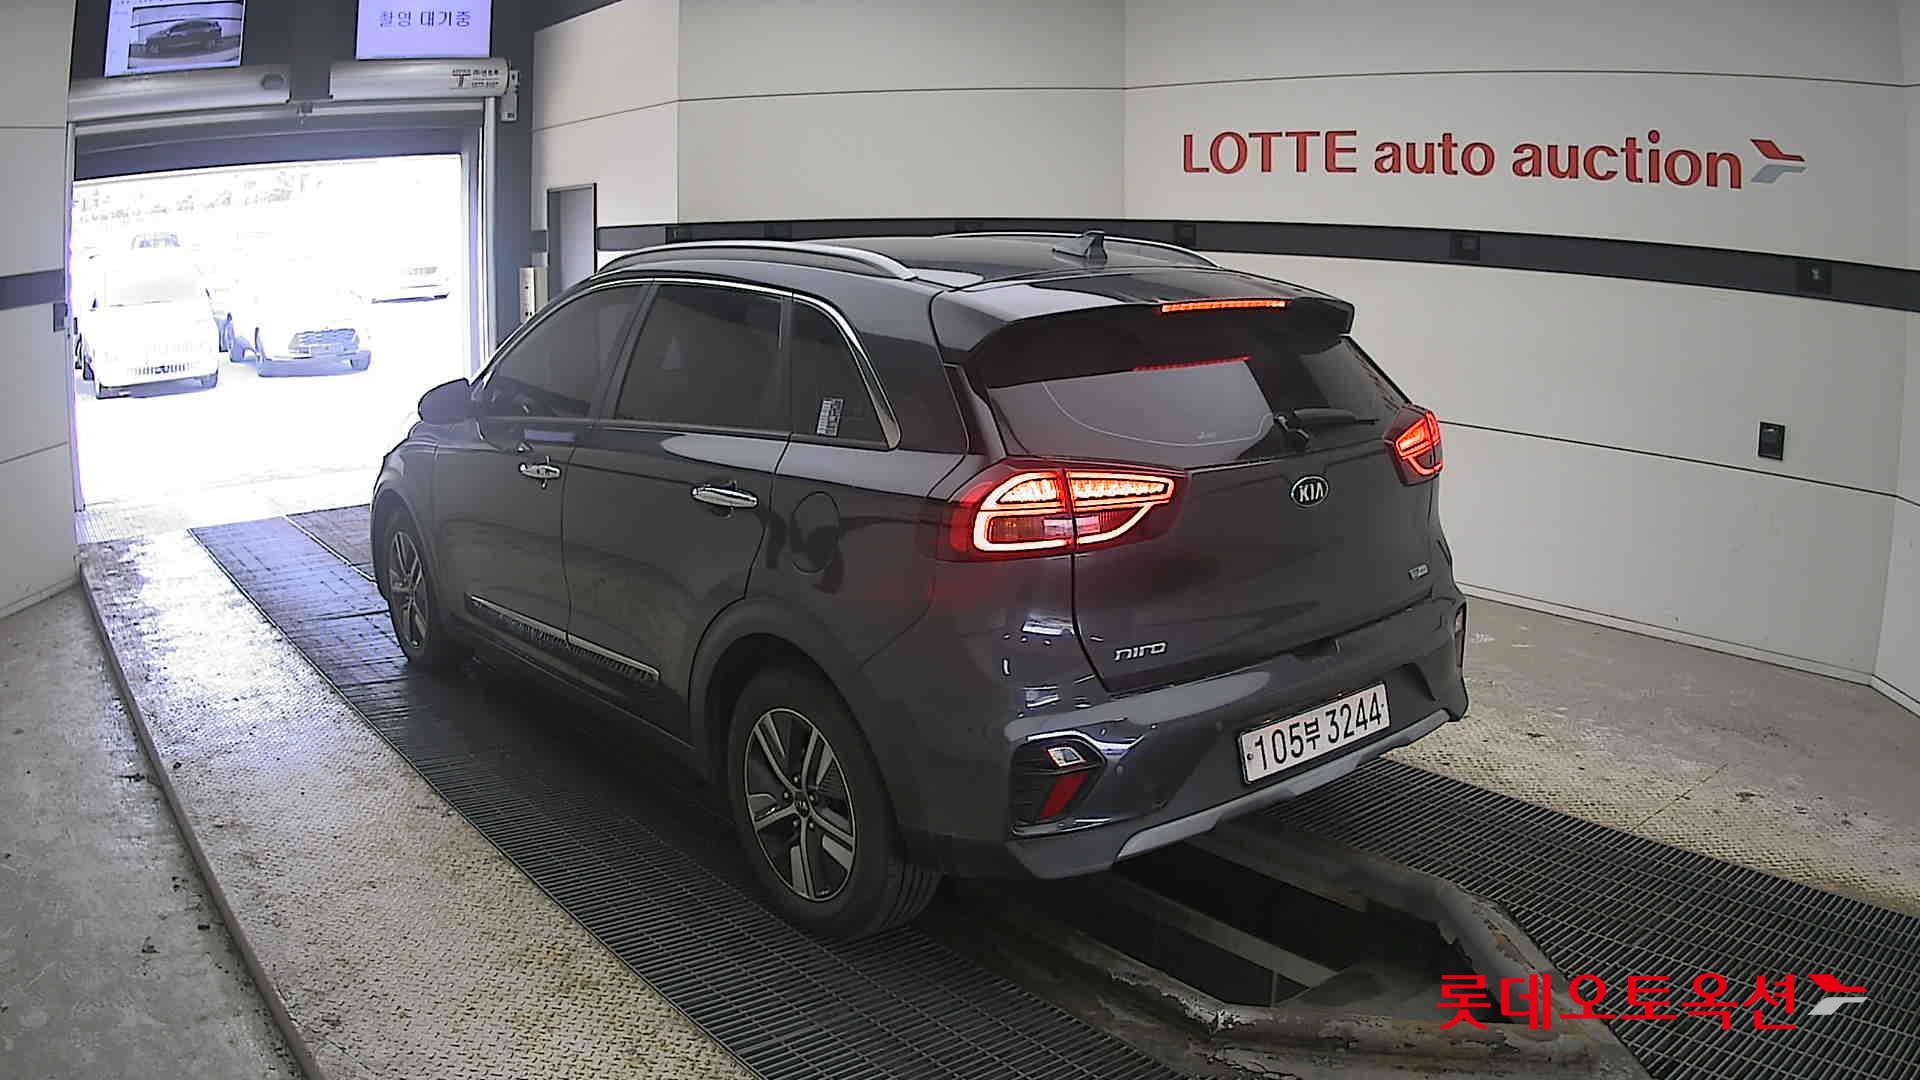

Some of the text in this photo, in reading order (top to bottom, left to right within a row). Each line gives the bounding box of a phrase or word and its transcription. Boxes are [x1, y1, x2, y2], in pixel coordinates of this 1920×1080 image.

[420, 10, 472, 28] 대기중
[1183, 129, 1743, 190] LOTTE auto auction
[1254, 691, 1382, 771] 105부 3244
